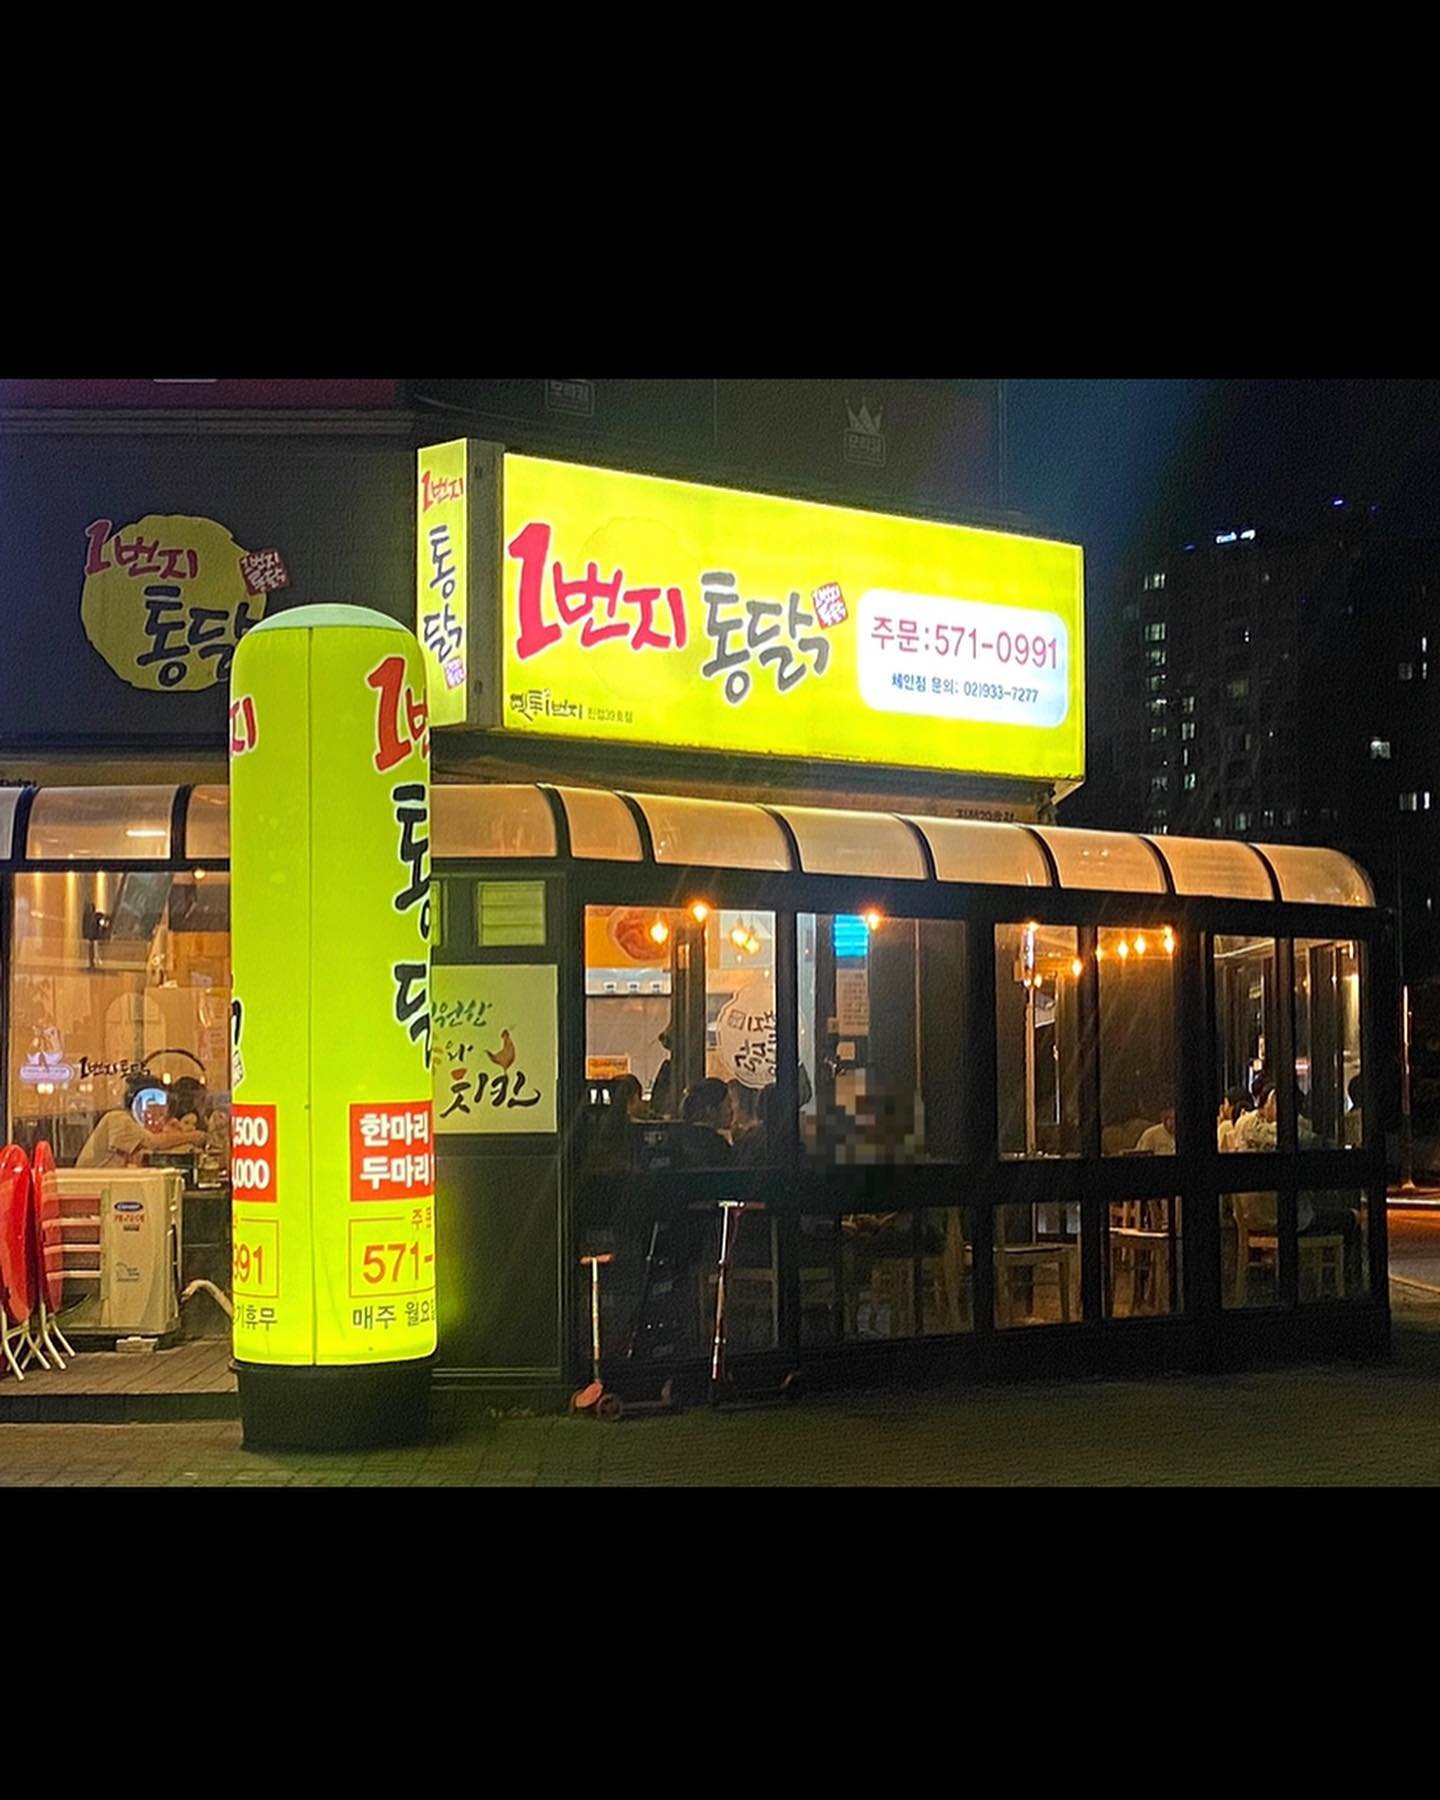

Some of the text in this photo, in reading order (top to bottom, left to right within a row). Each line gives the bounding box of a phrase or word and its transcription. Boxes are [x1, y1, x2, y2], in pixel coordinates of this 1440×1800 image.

[421, 470, 464, 512] 1번지
[85, 520, 198, 580] 1번지
[423, 524, 463, 663] 통닭
[508, 522, 829, 704] 1번지 통닭
[440, 1068, 541, 1118] 치킨
[360, 1112, 430, 1147] 한마리
[360, 1154, 430, 1190] 두마리
[352, 1305, 397, 1331] 매주
